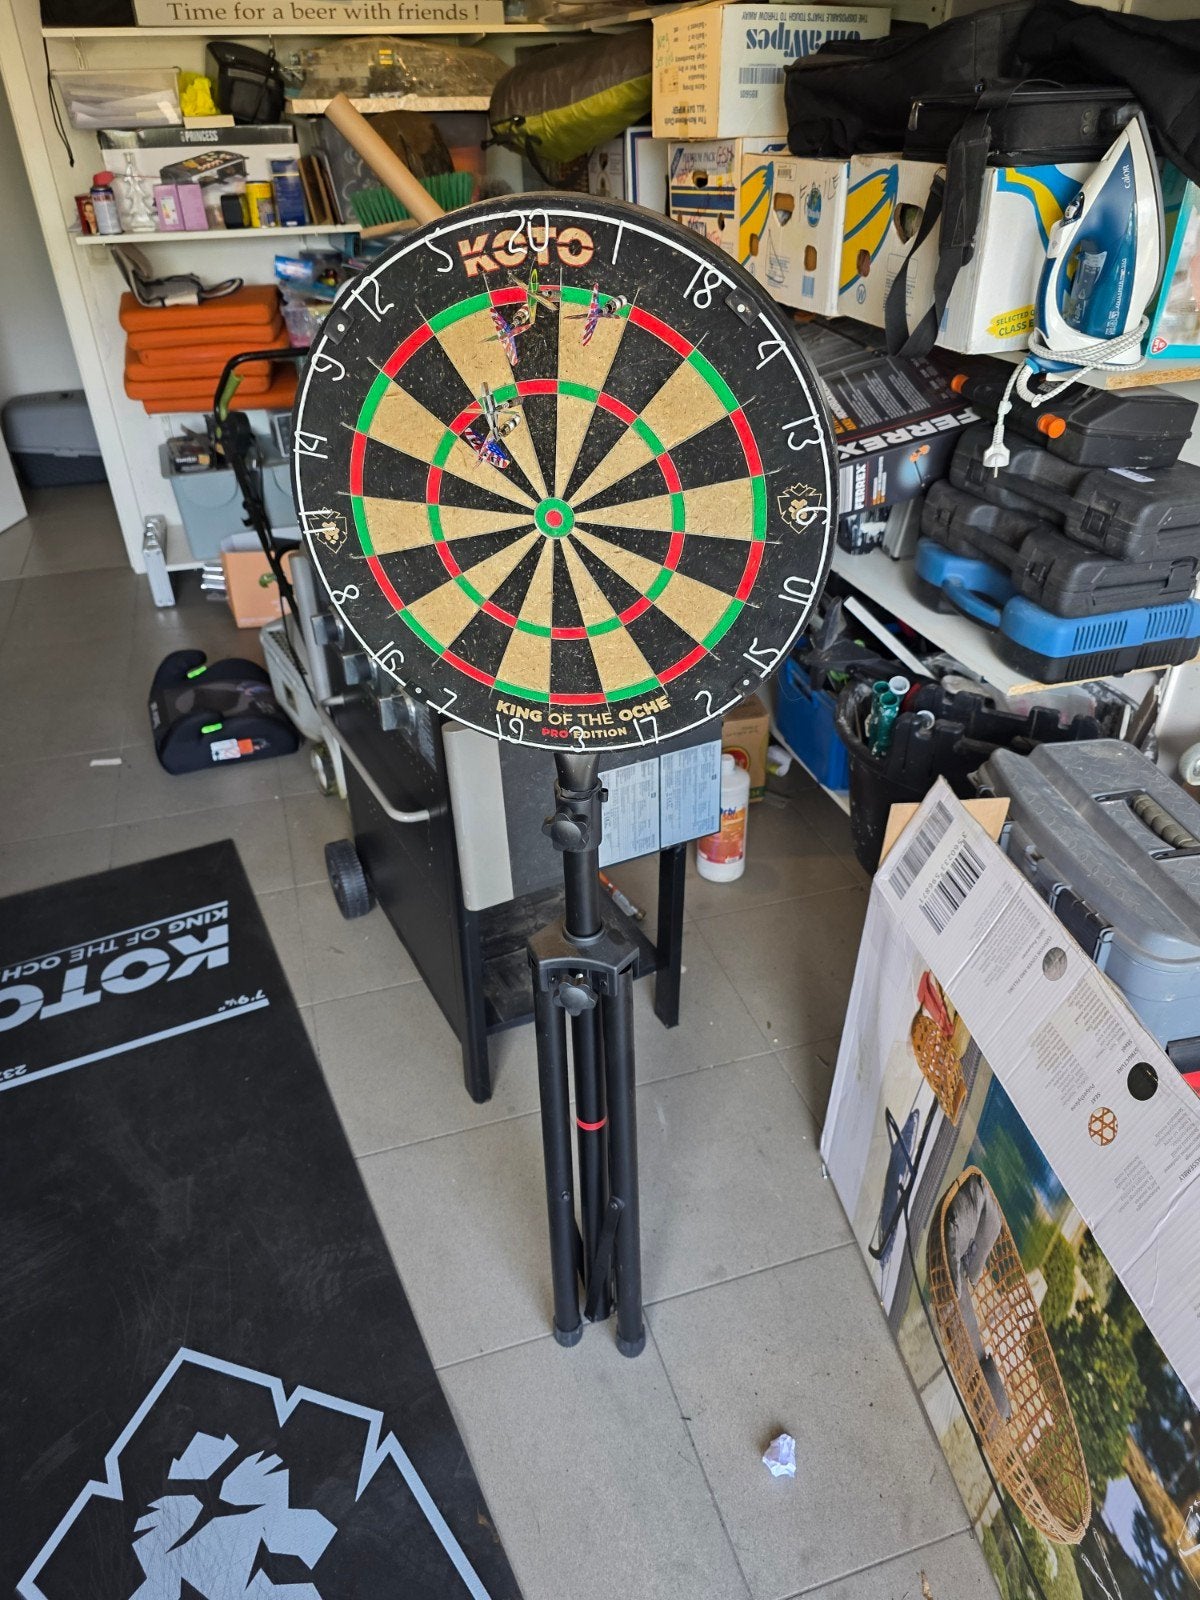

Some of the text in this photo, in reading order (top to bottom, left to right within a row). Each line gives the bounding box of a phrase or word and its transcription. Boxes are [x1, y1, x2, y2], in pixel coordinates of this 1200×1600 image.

[167, 3, 227, 21] Time
[234, 3, 264, 20] for
[273, 8, 283, 20] a
[291, 3, 344, 20] beer
[351, 2, 391, 20] with
[398, 2, 468, 21] friends
[858, 15, 868, 23] THE
[185, 130, 218, 142] PRINCESS
[505, 208, 549, 253] 20
[612, 219, 624, 265] 1
[424, 227, 453, 272] 5
[458, 227, 594, 278] KOTO
[351, 276, 396, 323] 12
[683, 262, 723, 309] 18
[996, 311, 1028, 326] SELECTED
[999, 321, 1027, 336] CLASS
[312, 353, 346, 382] 9
[756, 340, 786, 370] 4
[293, 431, 328, 459] 14
[782, 414, 824, 450] 13
[836, 407, 982, 460] FERREX
[854, 463, 866, 510] FERREX
[298, 508, 336, 534] 11
[796, 506, 832, 526] 6
[331, 584, 360, 604] 8
[778, 576, 816, 606] 10
[372, 640, 404, 672] 16
[742, 638, 782, 672] 15
[438, 687, 458, 714] 7
[495, 696, 671, 726] KING OF THE OCHE
[694, 690, 721, 716] 2
[496, 714, 524, 744] 19
[541, 727, 627, 739] PRO EDITION
[569, 726, 585, 752] 3
[633, 716, 659, 746] 17
[168, 907, 228, 934] KING
[69, 939, 119, 964] THE
[126, 927, 160, 947] OF
[0, 924, 229, 1032] KOTO
[1116, 1047, 1139, 1074] STRUCTURE
